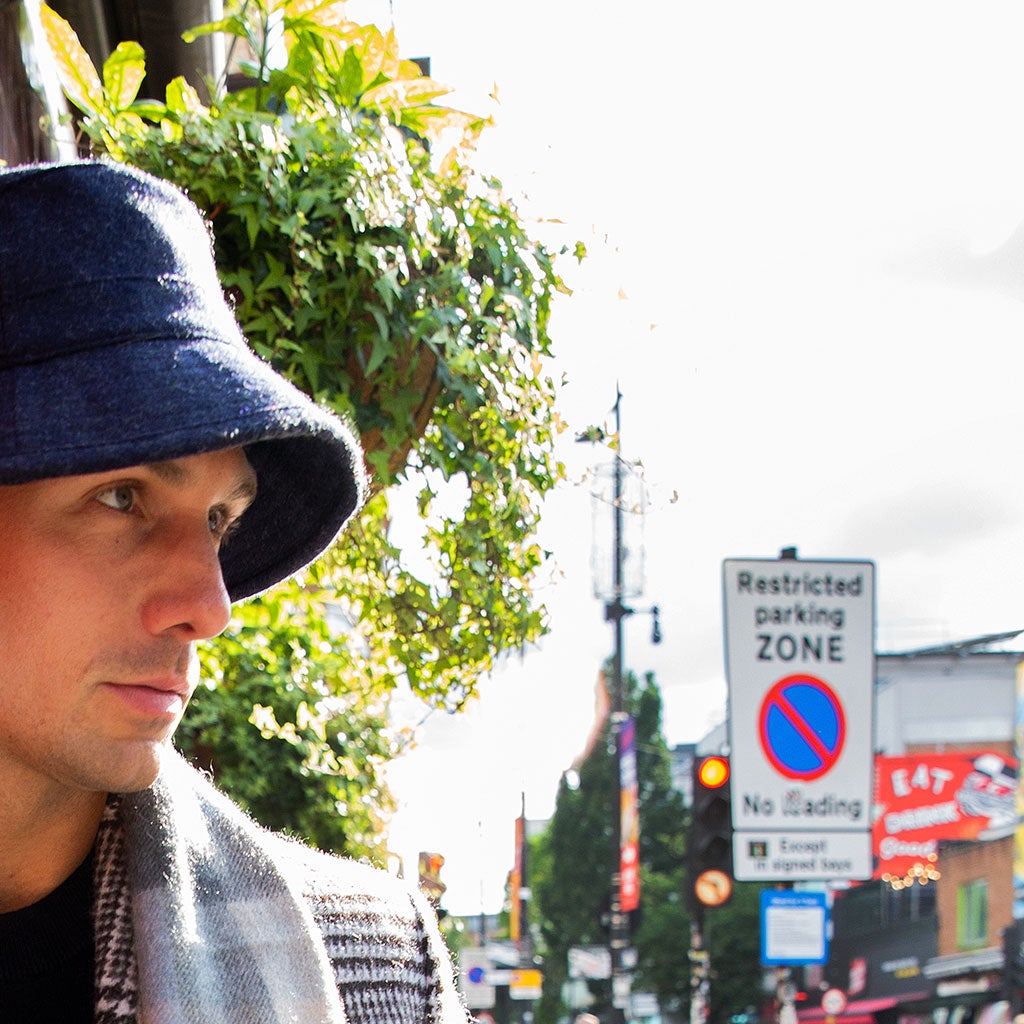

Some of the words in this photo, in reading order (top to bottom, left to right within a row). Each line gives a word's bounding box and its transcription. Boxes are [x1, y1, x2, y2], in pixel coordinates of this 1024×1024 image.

[737, 571, 864, 596] Restricted
[755, 602, 845, 630] parking
[757, 634, 844, 662] ZONE
[891, 763, 954, 797] EAT
[743, 795, 774, 816] No
[782, 793, 862, 820] ading
